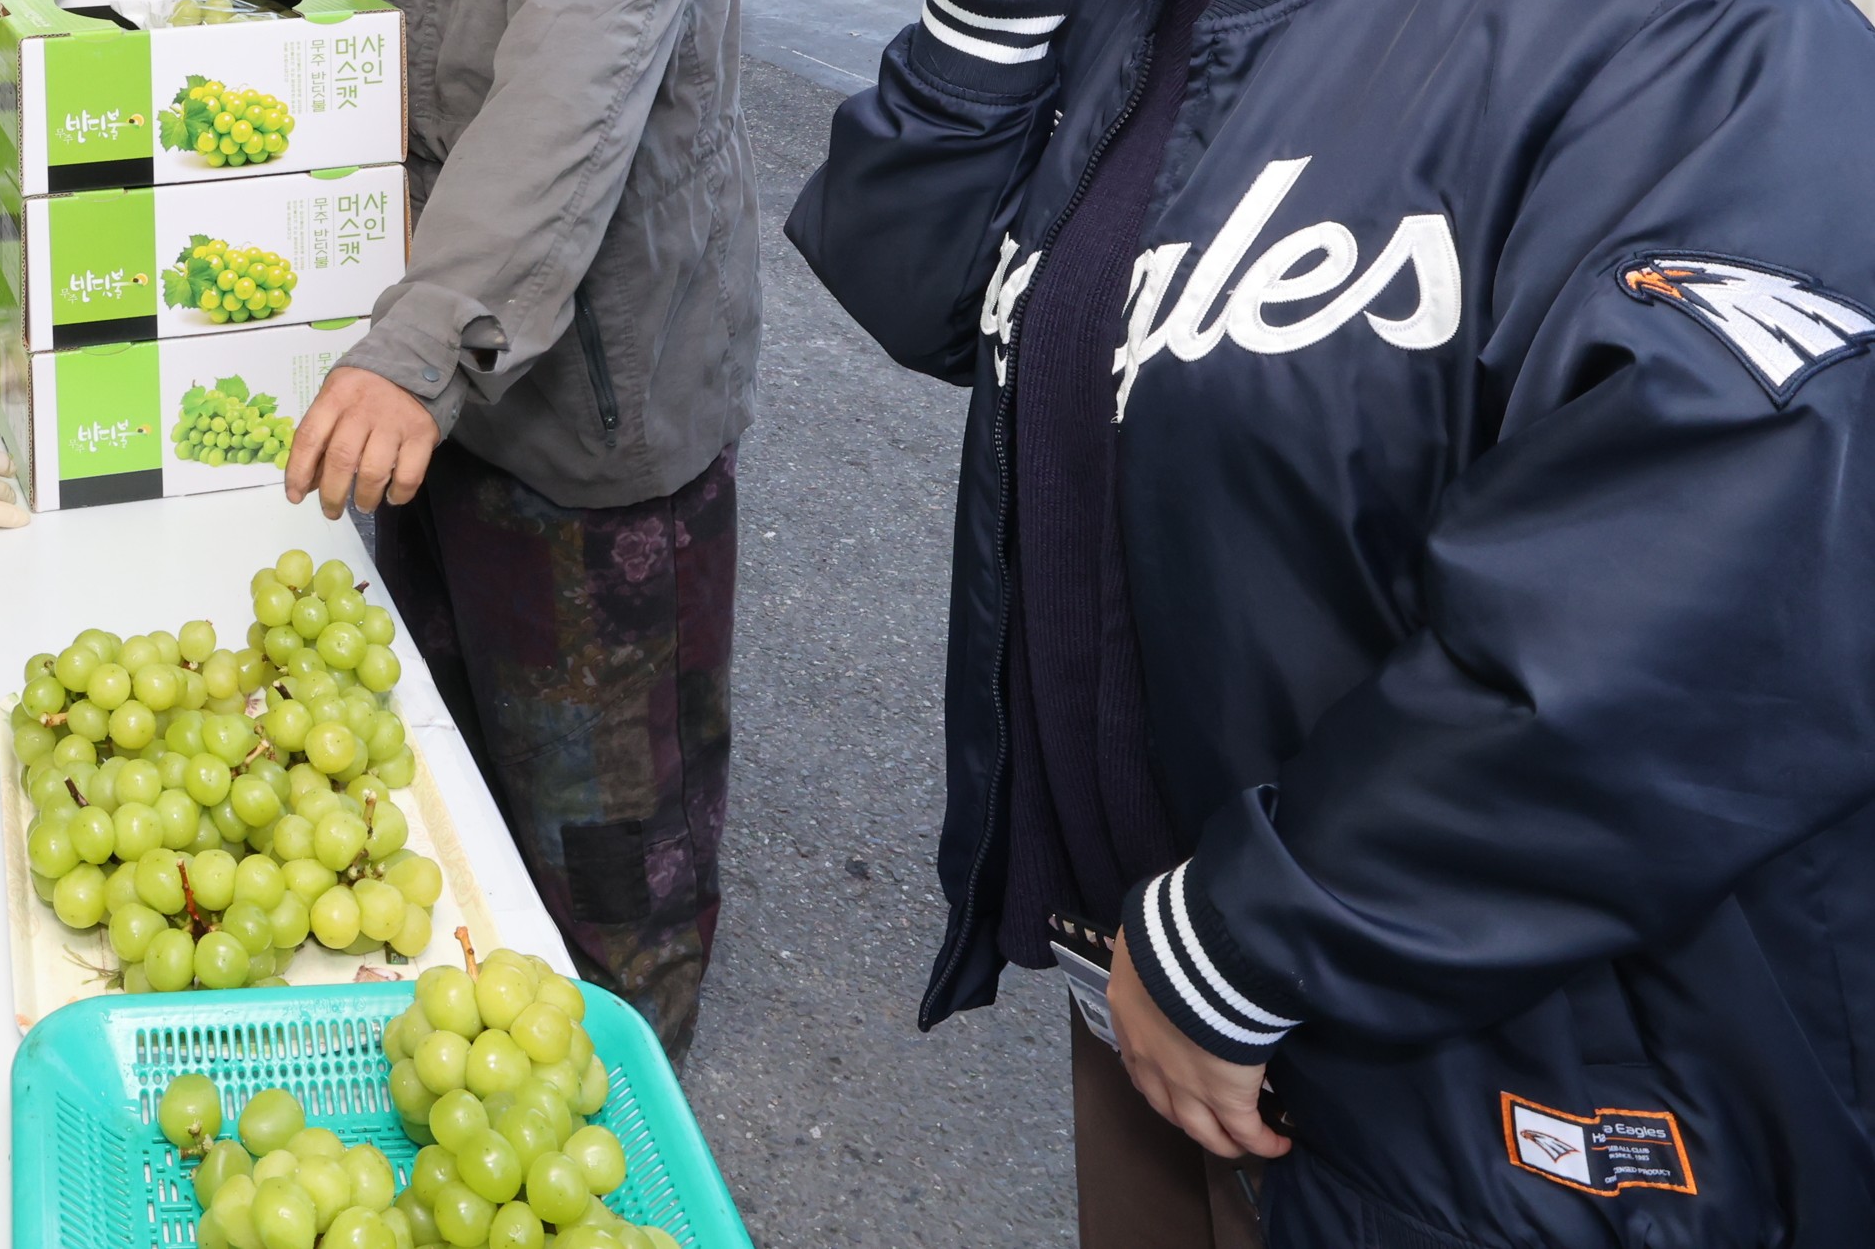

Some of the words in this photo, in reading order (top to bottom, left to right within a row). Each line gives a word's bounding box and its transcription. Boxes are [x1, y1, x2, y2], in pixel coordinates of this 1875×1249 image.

[310, 39, 325, 66] 무주
[361, 33, 385, 85] 샤인
[335, 36, 358, 110] 머스캣
[65, 109, 121, 143] 반딧불
[313, 197, 328, 224] 무주
[364, 191, 387, 240] 샤인
[337, 193, 361, 265] 머스캣
[70, 268, 125, 303] 반딧불
[77, 419, 130, 452] 반딧불
[1615, 1123, 1666, 1139] Eagles
[1638, 1167, 1671, 1176] PRODUCT
